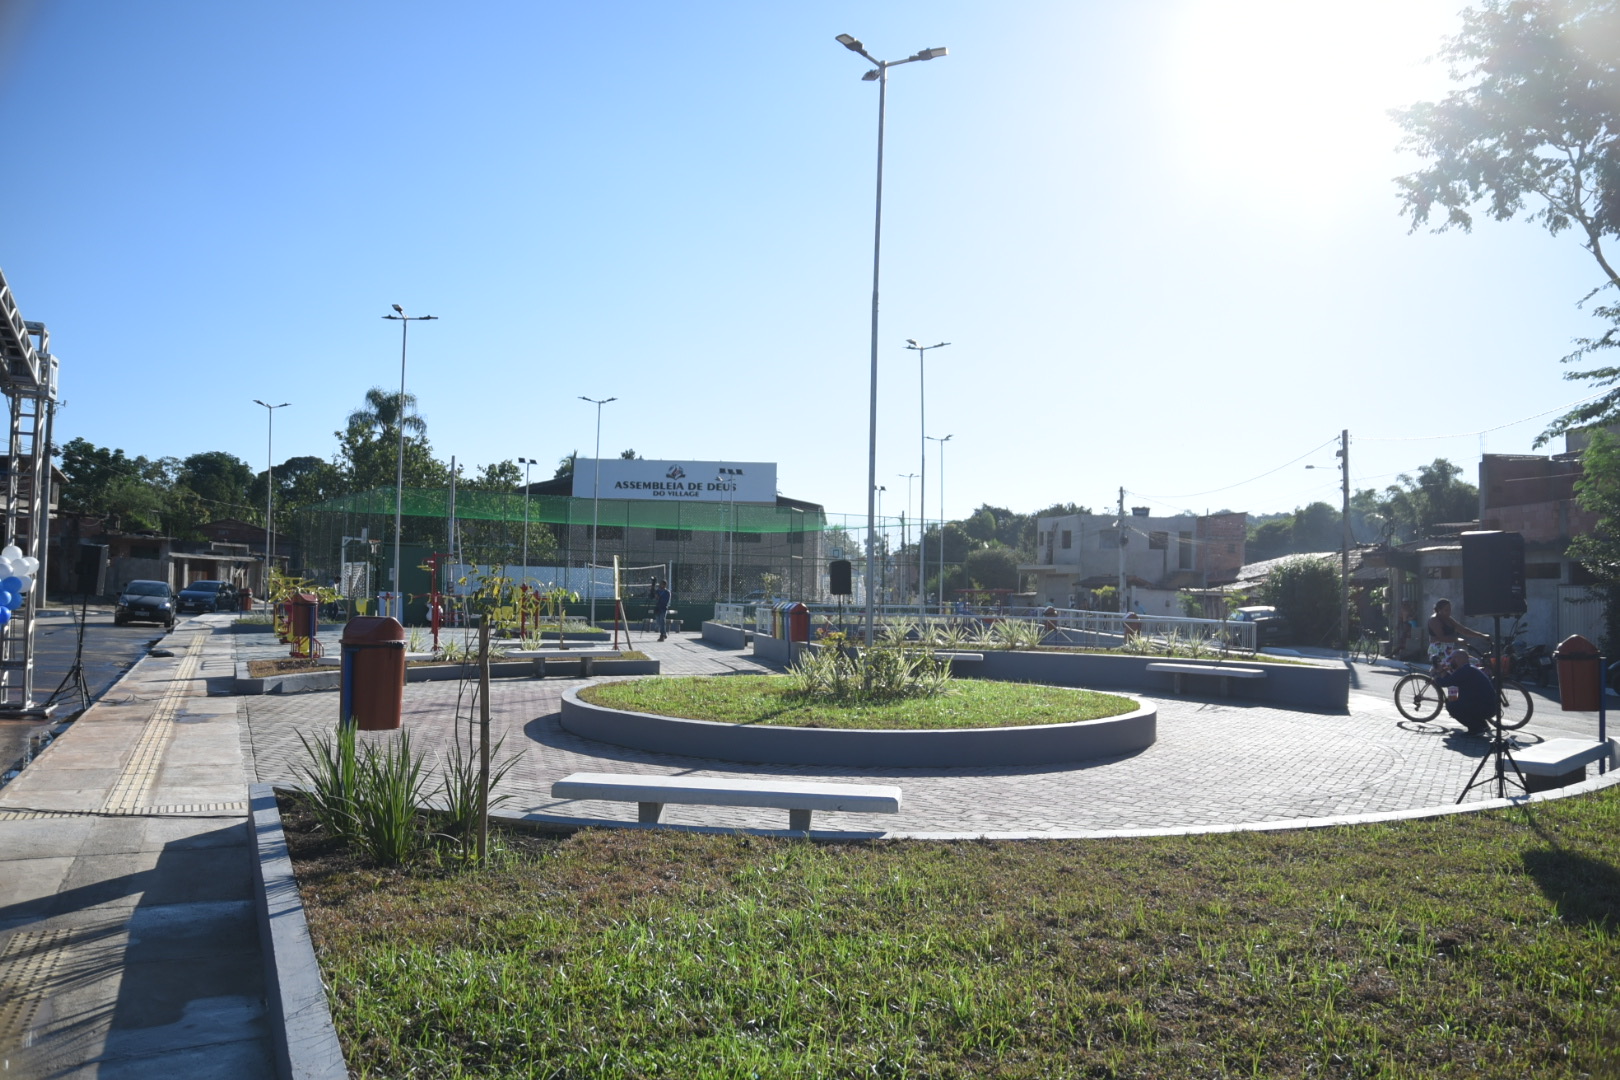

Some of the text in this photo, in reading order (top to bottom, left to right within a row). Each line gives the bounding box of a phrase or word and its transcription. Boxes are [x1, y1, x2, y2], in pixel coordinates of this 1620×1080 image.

[615, 481, 737, 492] ASSEMBLEIA DE DEUS
